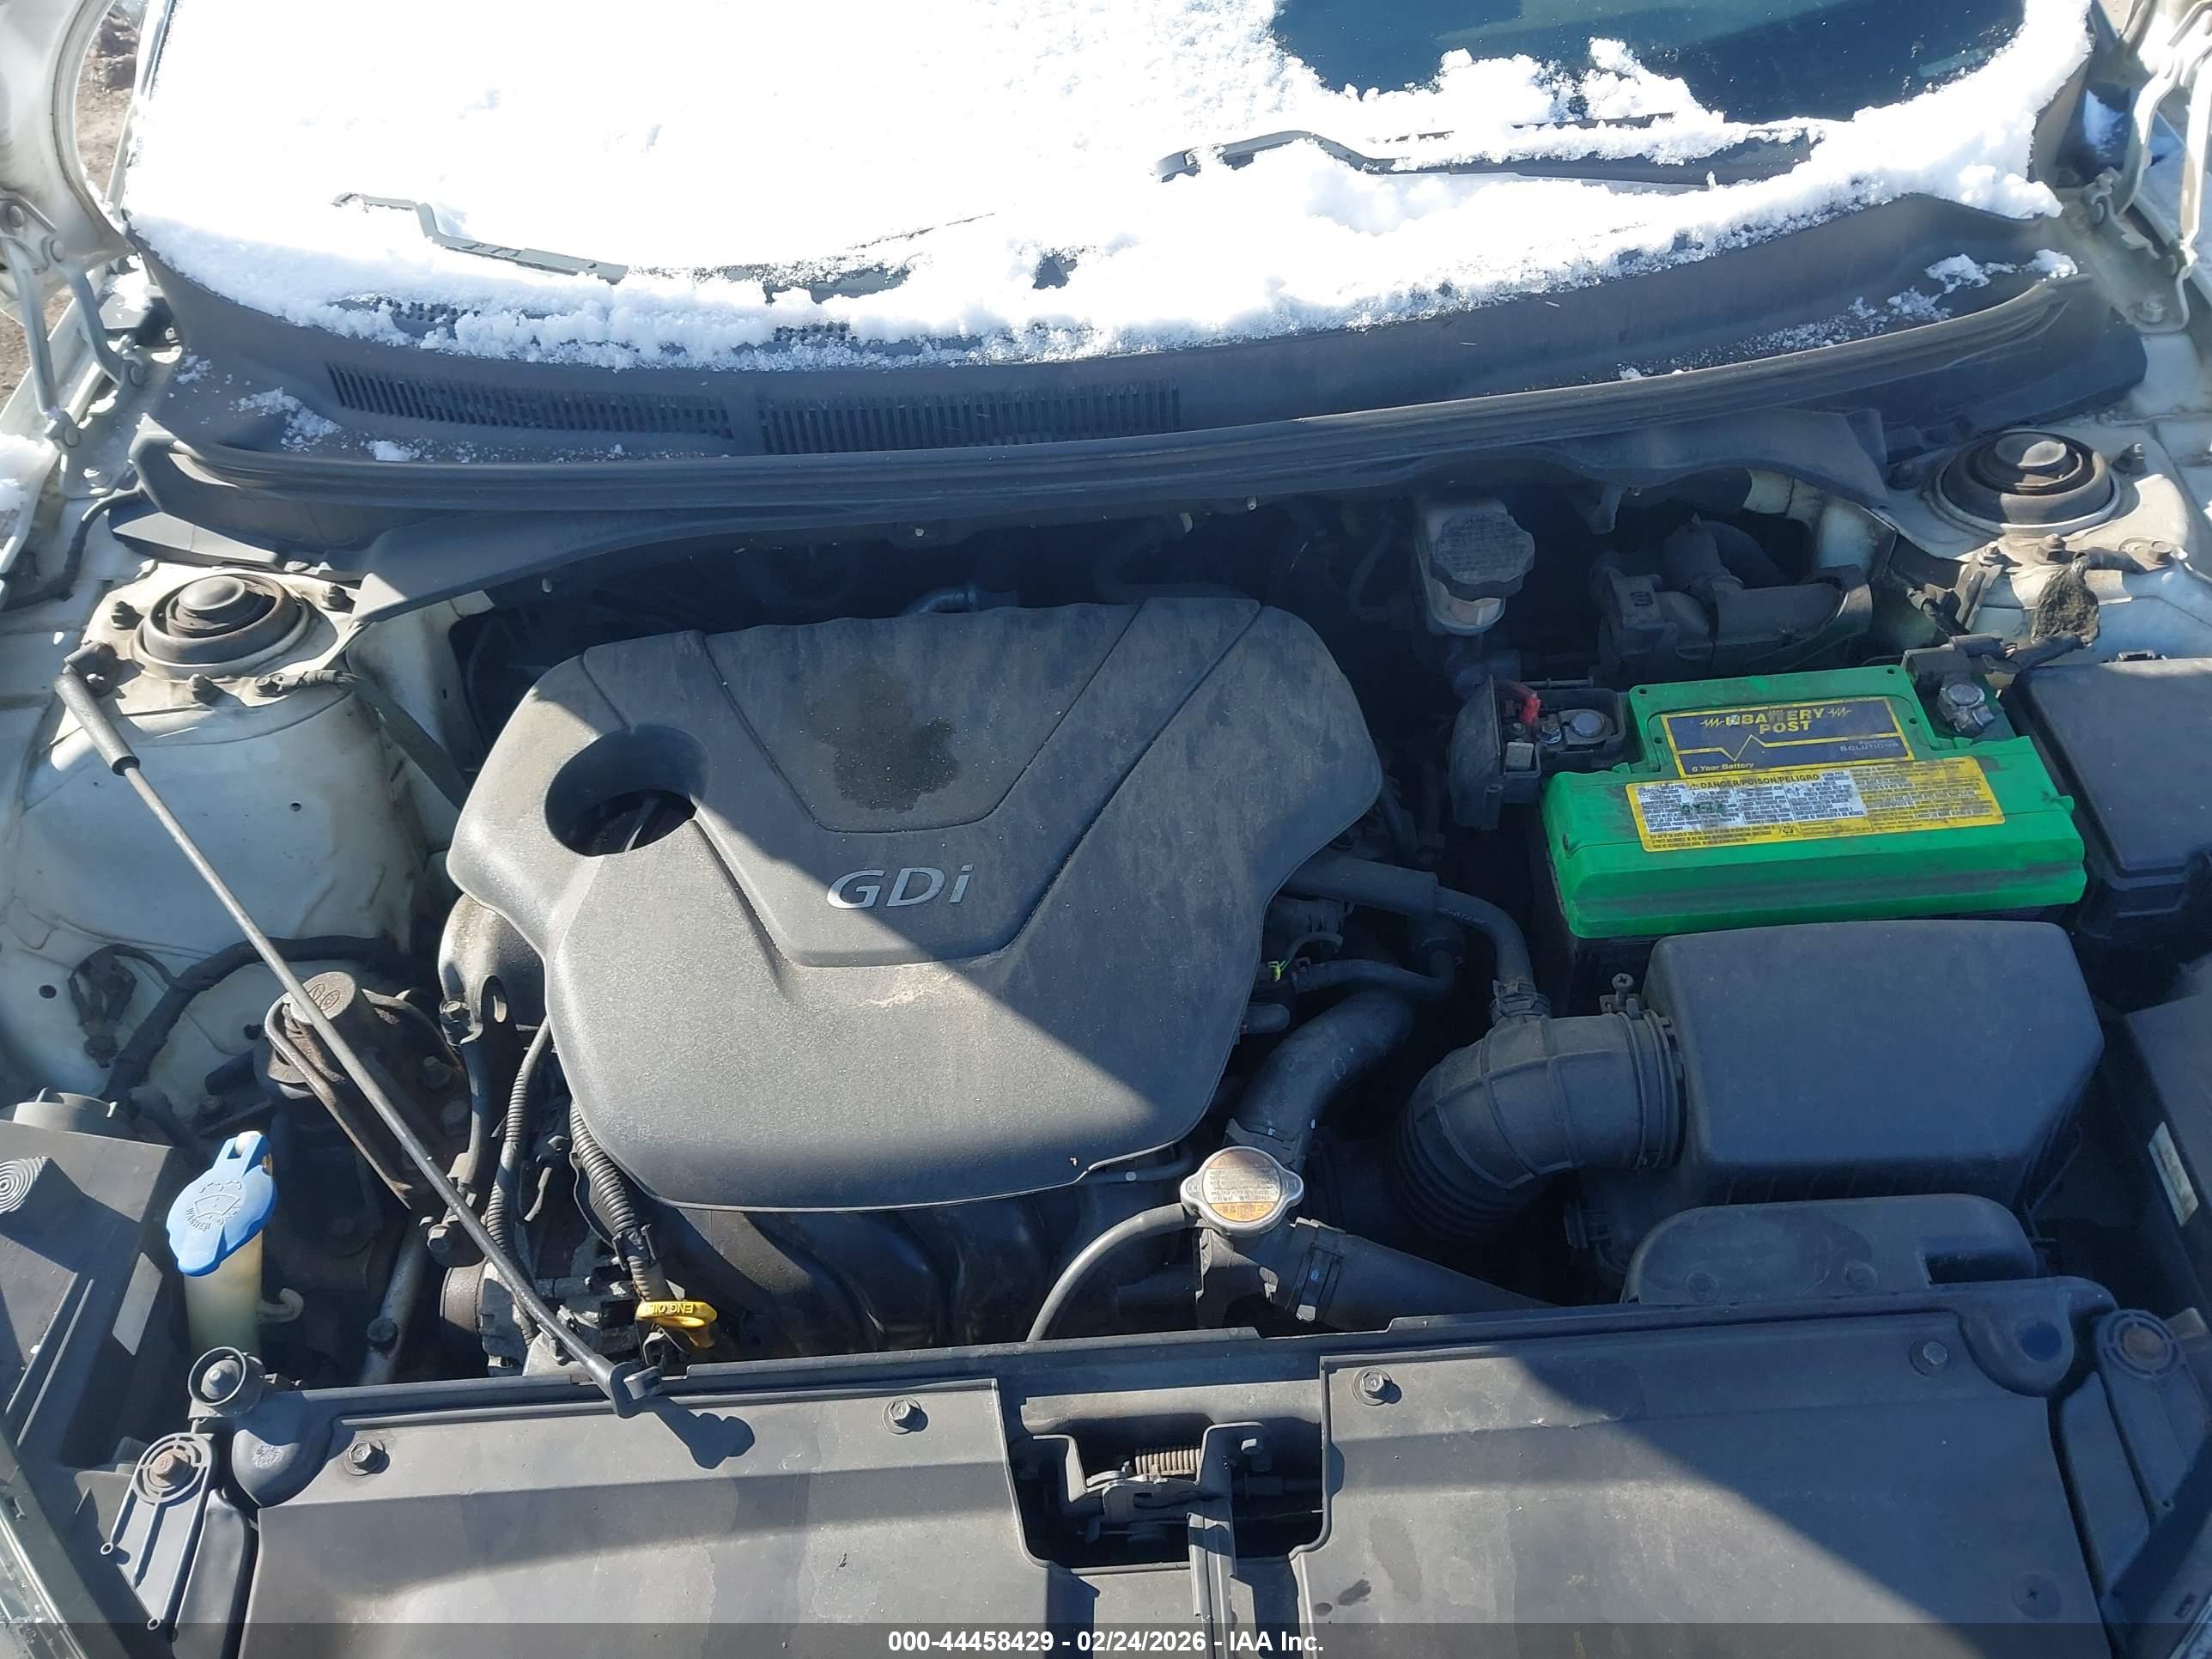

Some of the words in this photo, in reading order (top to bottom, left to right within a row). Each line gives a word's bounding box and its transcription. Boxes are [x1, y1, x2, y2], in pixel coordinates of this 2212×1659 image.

[1759, 720, 1812, 735] POST
[1700, 773, 1820, 789] DANGER/POISON/PELIGRO
[825, 863, 975, 910] GDi
[185, 1206, 211, 1232] WASHER
[669, 1304, 694, 1314] ENG
